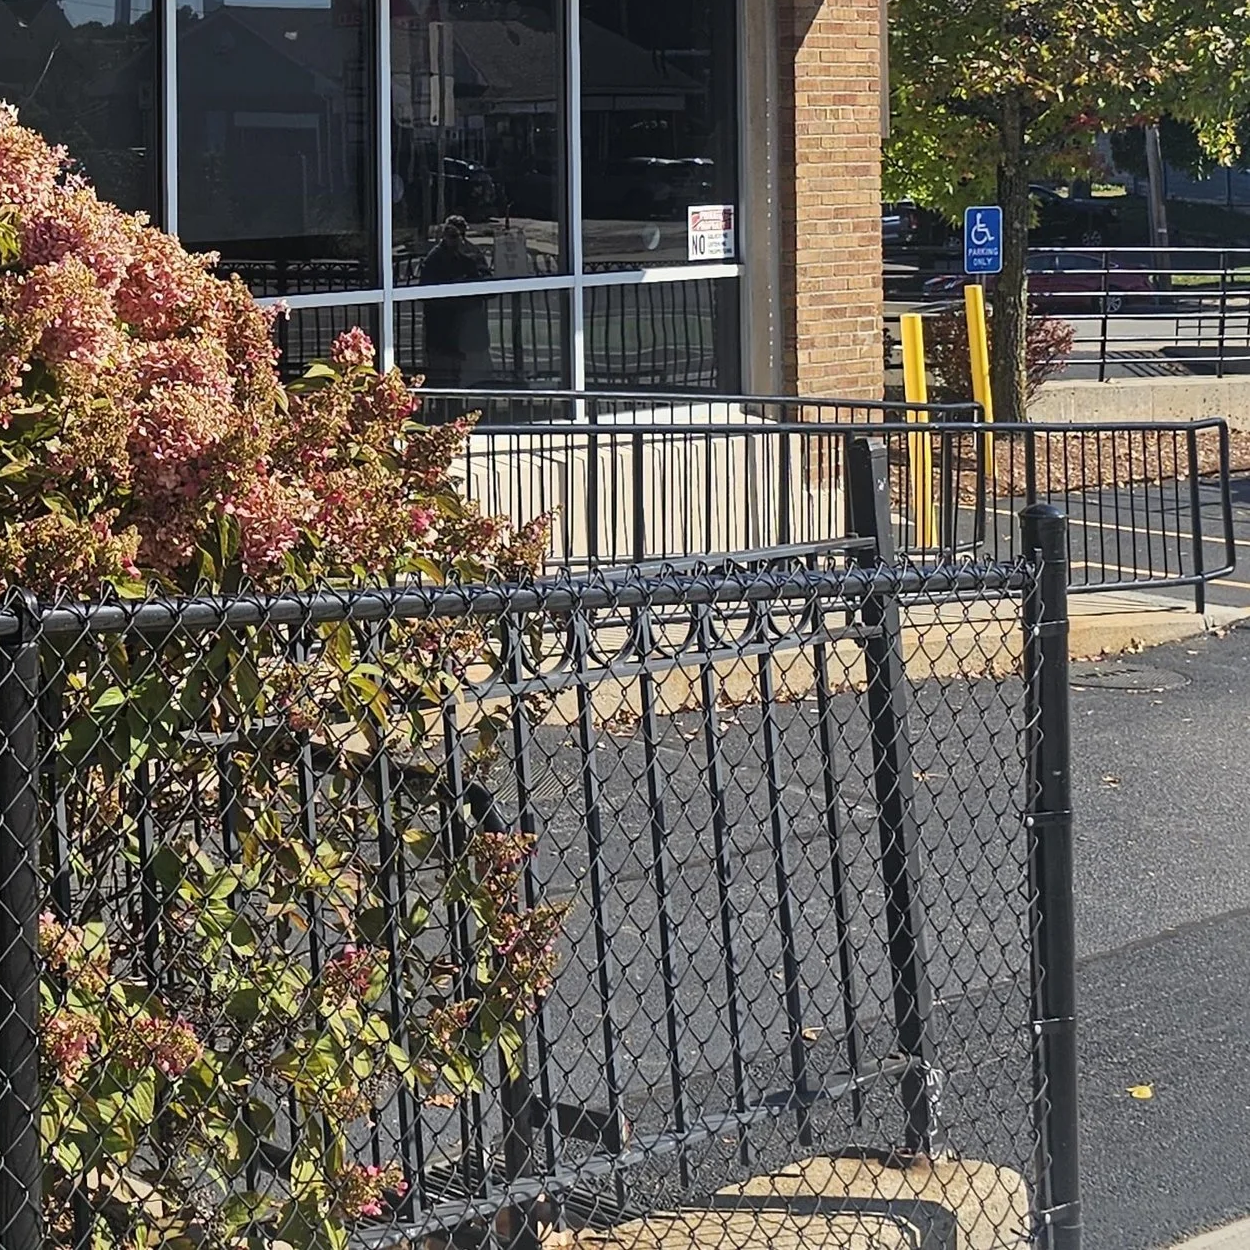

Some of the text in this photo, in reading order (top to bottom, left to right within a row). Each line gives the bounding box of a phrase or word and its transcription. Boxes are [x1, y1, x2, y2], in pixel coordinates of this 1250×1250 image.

[692, 234, 706, 255] NO
[968, 247, 999, 256] PARKING
[973, 258, 993, 266] ONLY
